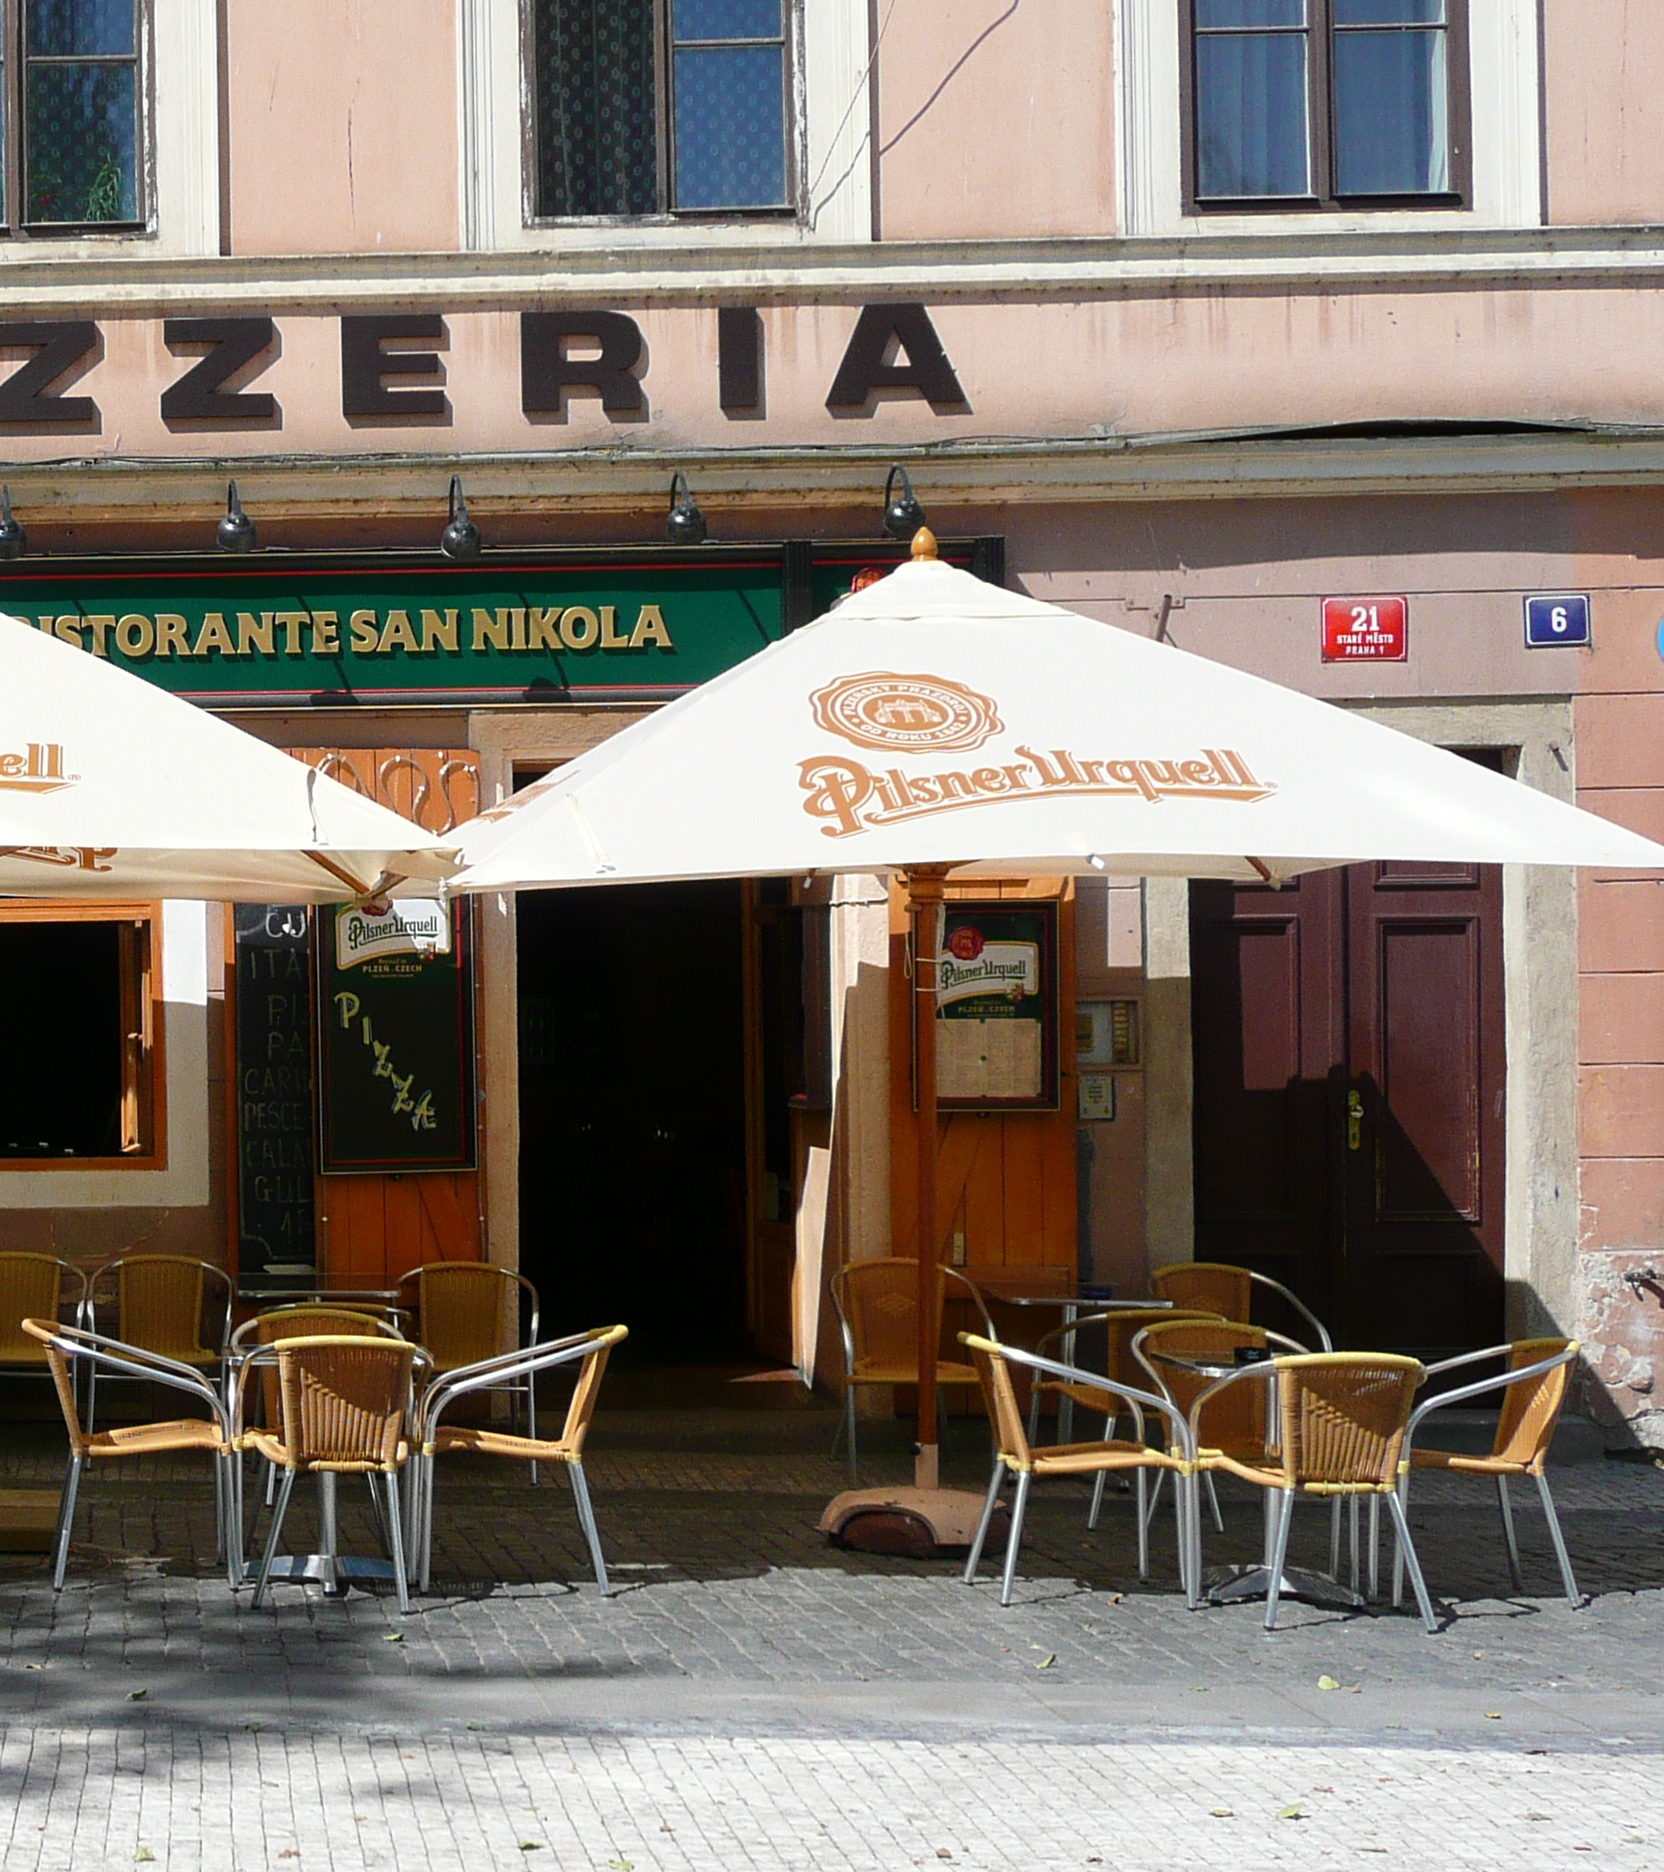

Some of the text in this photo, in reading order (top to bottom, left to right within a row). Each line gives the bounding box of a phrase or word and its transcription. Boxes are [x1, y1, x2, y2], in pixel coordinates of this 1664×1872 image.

[11, 604, 673, 656] ISTORANTE SAN NIKOLA
[1351, 605, 1380, 632] 21
[1551, 606, 1568, 633] 6
[1336, 631, 1394, 644] STARÉ MĚSTO
[1346, 645, 1375, 655] PRAHA
[860, 721, 966, 741] OD ROKU 1842
[794, 744, 1261, 839] Pilsner Urquell
[347, 914, 438, 951] Pilsner Urquell
[940, 958, 1026, 990] Pilsner Urquell
[333, 991, 438, 1131] PIZZA
